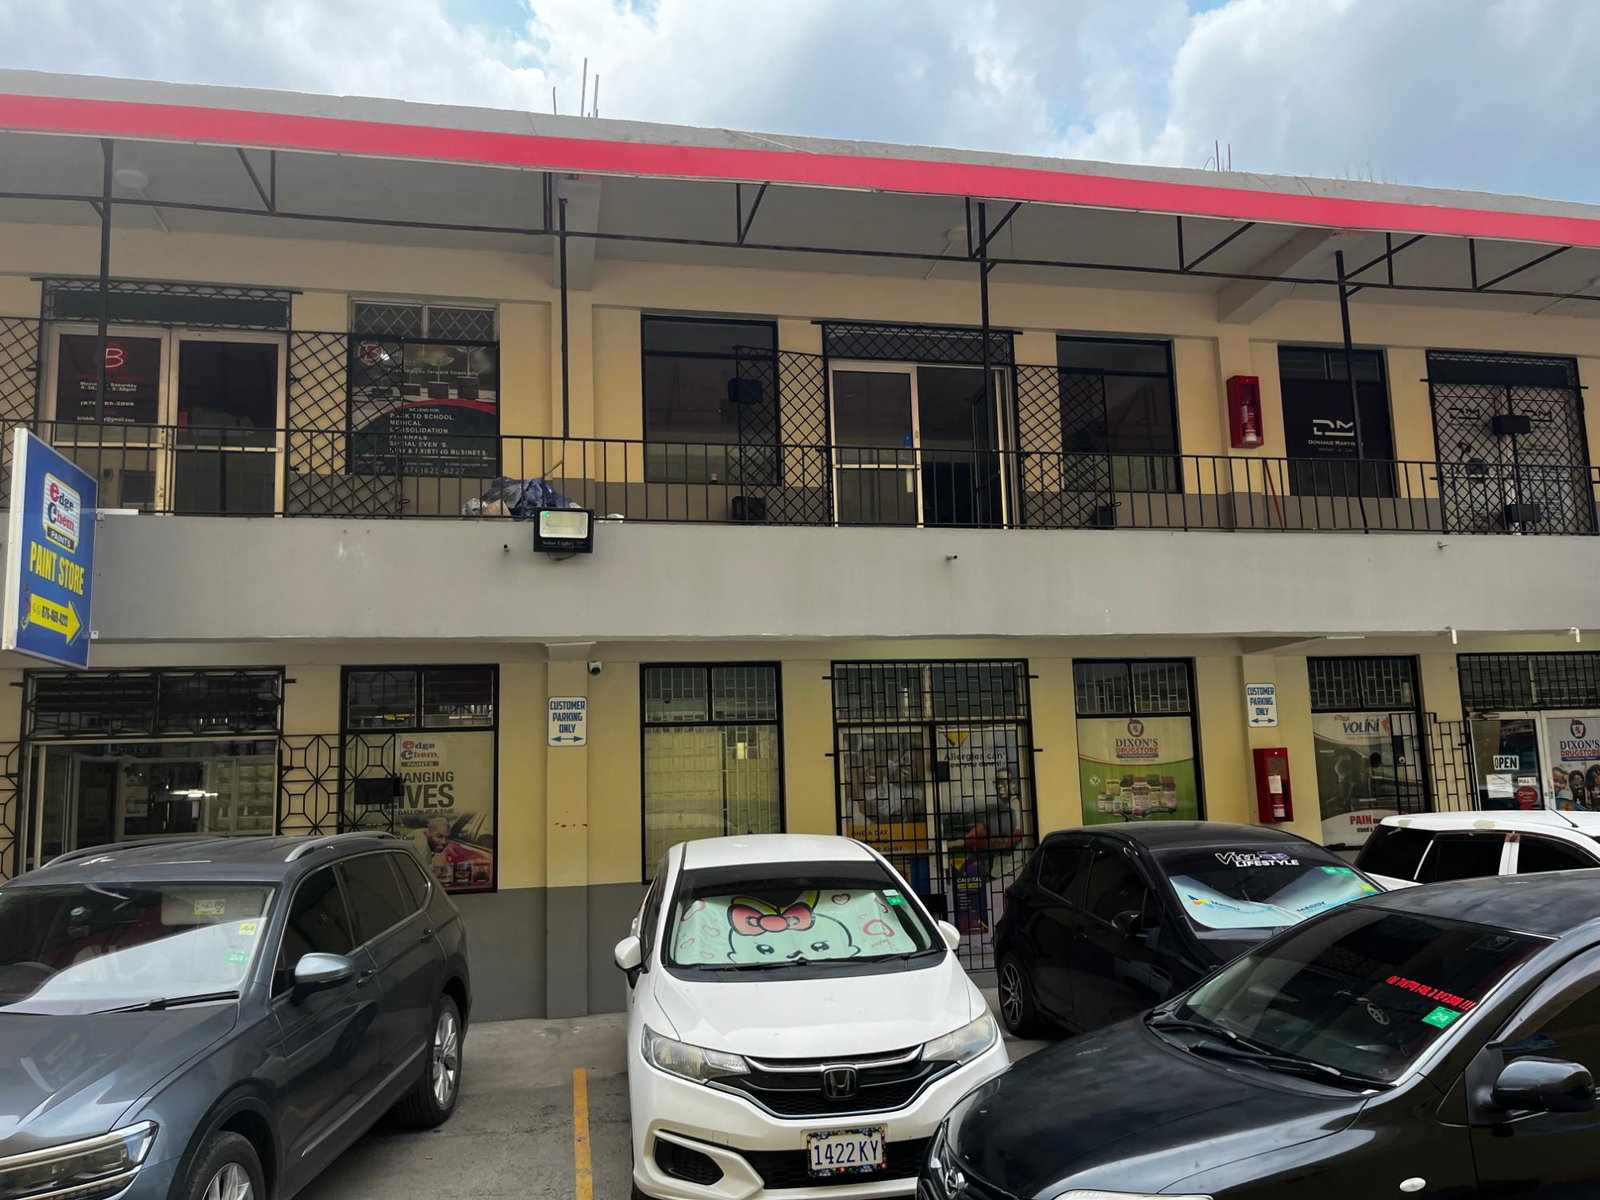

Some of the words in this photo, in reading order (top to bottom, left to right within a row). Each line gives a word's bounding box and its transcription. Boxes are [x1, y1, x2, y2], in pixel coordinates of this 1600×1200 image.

[49, 482, 74, 512] edge
[50, 530, 72, 548] PAINTS
[30, 541, 57, 582] PAINT
[58, 556, 85, 596] STORE
[1247, 687, 1275, 695] CUSTOMER
[550, 701, 586, 710] CUSTOMER
[1250, 697, 1273, 705] PARKING
[1256, 707, 1269, 715] ONLY
[553, 712, 583, 722] PARKING
[559, 724, 576, 733] ONLY
[402, 740, 436, 750] edge
[1115, 738, 1159, 747] DIXON'S
[1560, 740, 1600, 750] DIXON'S
[1494, 757, 1518, 769] OPEN
[1350, 815, 1372, 825] PAIN
[1236, 859, 1300, 867] LIFESTYLE
